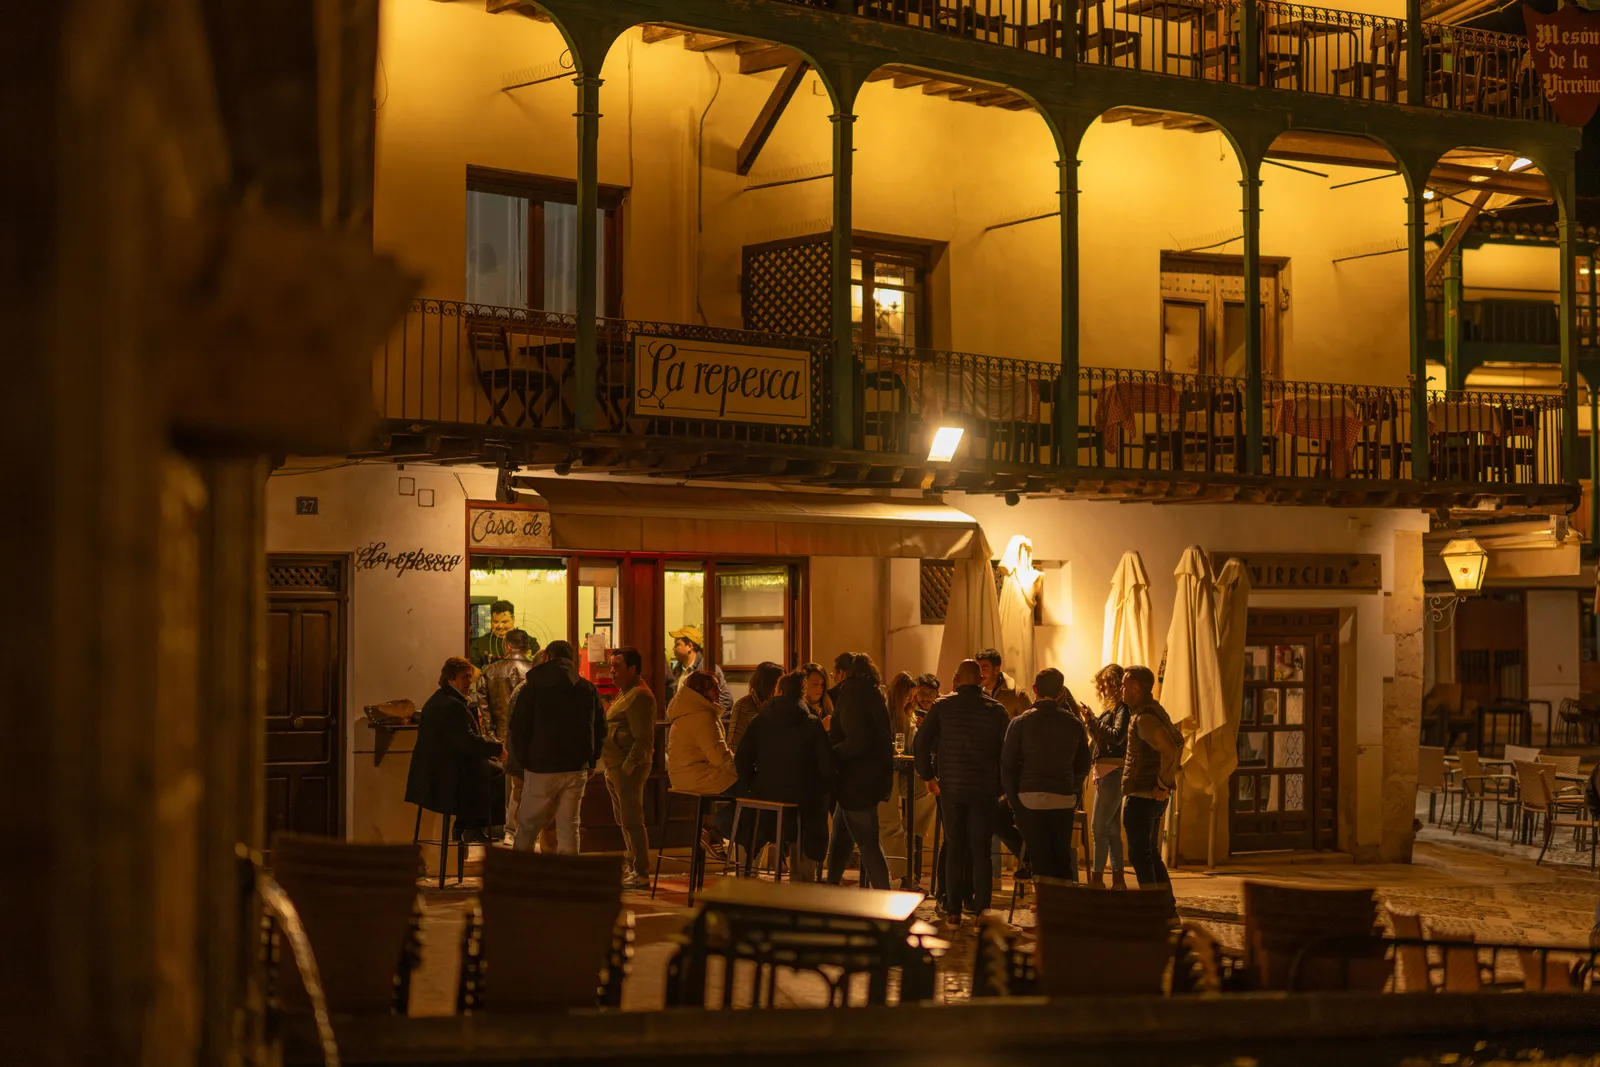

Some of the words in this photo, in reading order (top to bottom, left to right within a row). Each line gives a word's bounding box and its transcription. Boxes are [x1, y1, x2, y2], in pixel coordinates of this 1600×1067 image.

[1536, 24, 1599, 52] Mesón
[1549, 48, 1566, 69] de
[1573, 48, 1588, 69] la
[637, 341, 685, 410] La
[694, 362, 803, 417] repesca
[301, 500, 315, 512] 27
[471, 510, 518, 543] Casa
[523, 512, 542, 537] de
[355, 542, 388, 568] La
